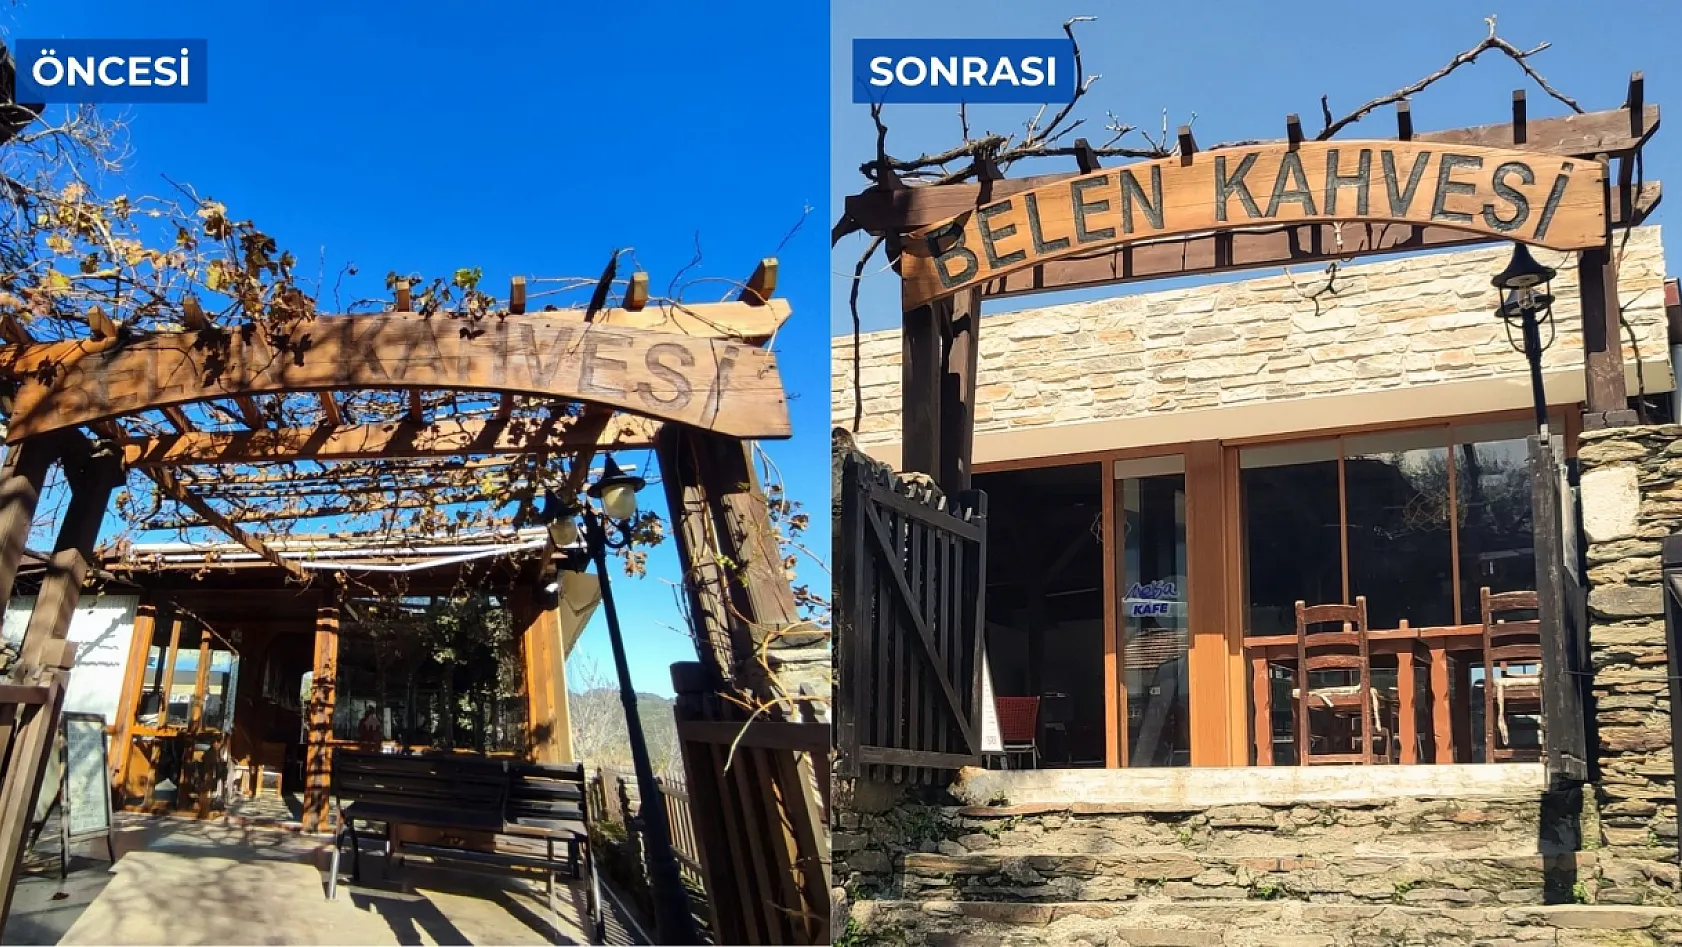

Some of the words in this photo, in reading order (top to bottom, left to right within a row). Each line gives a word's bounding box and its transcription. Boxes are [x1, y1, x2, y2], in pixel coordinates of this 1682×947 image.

[924, 163, 1165, 289] BELEN
[1214, 148, 1575, 241] KAHVESİ
[1132, 602, 1169, 616] KAFE
